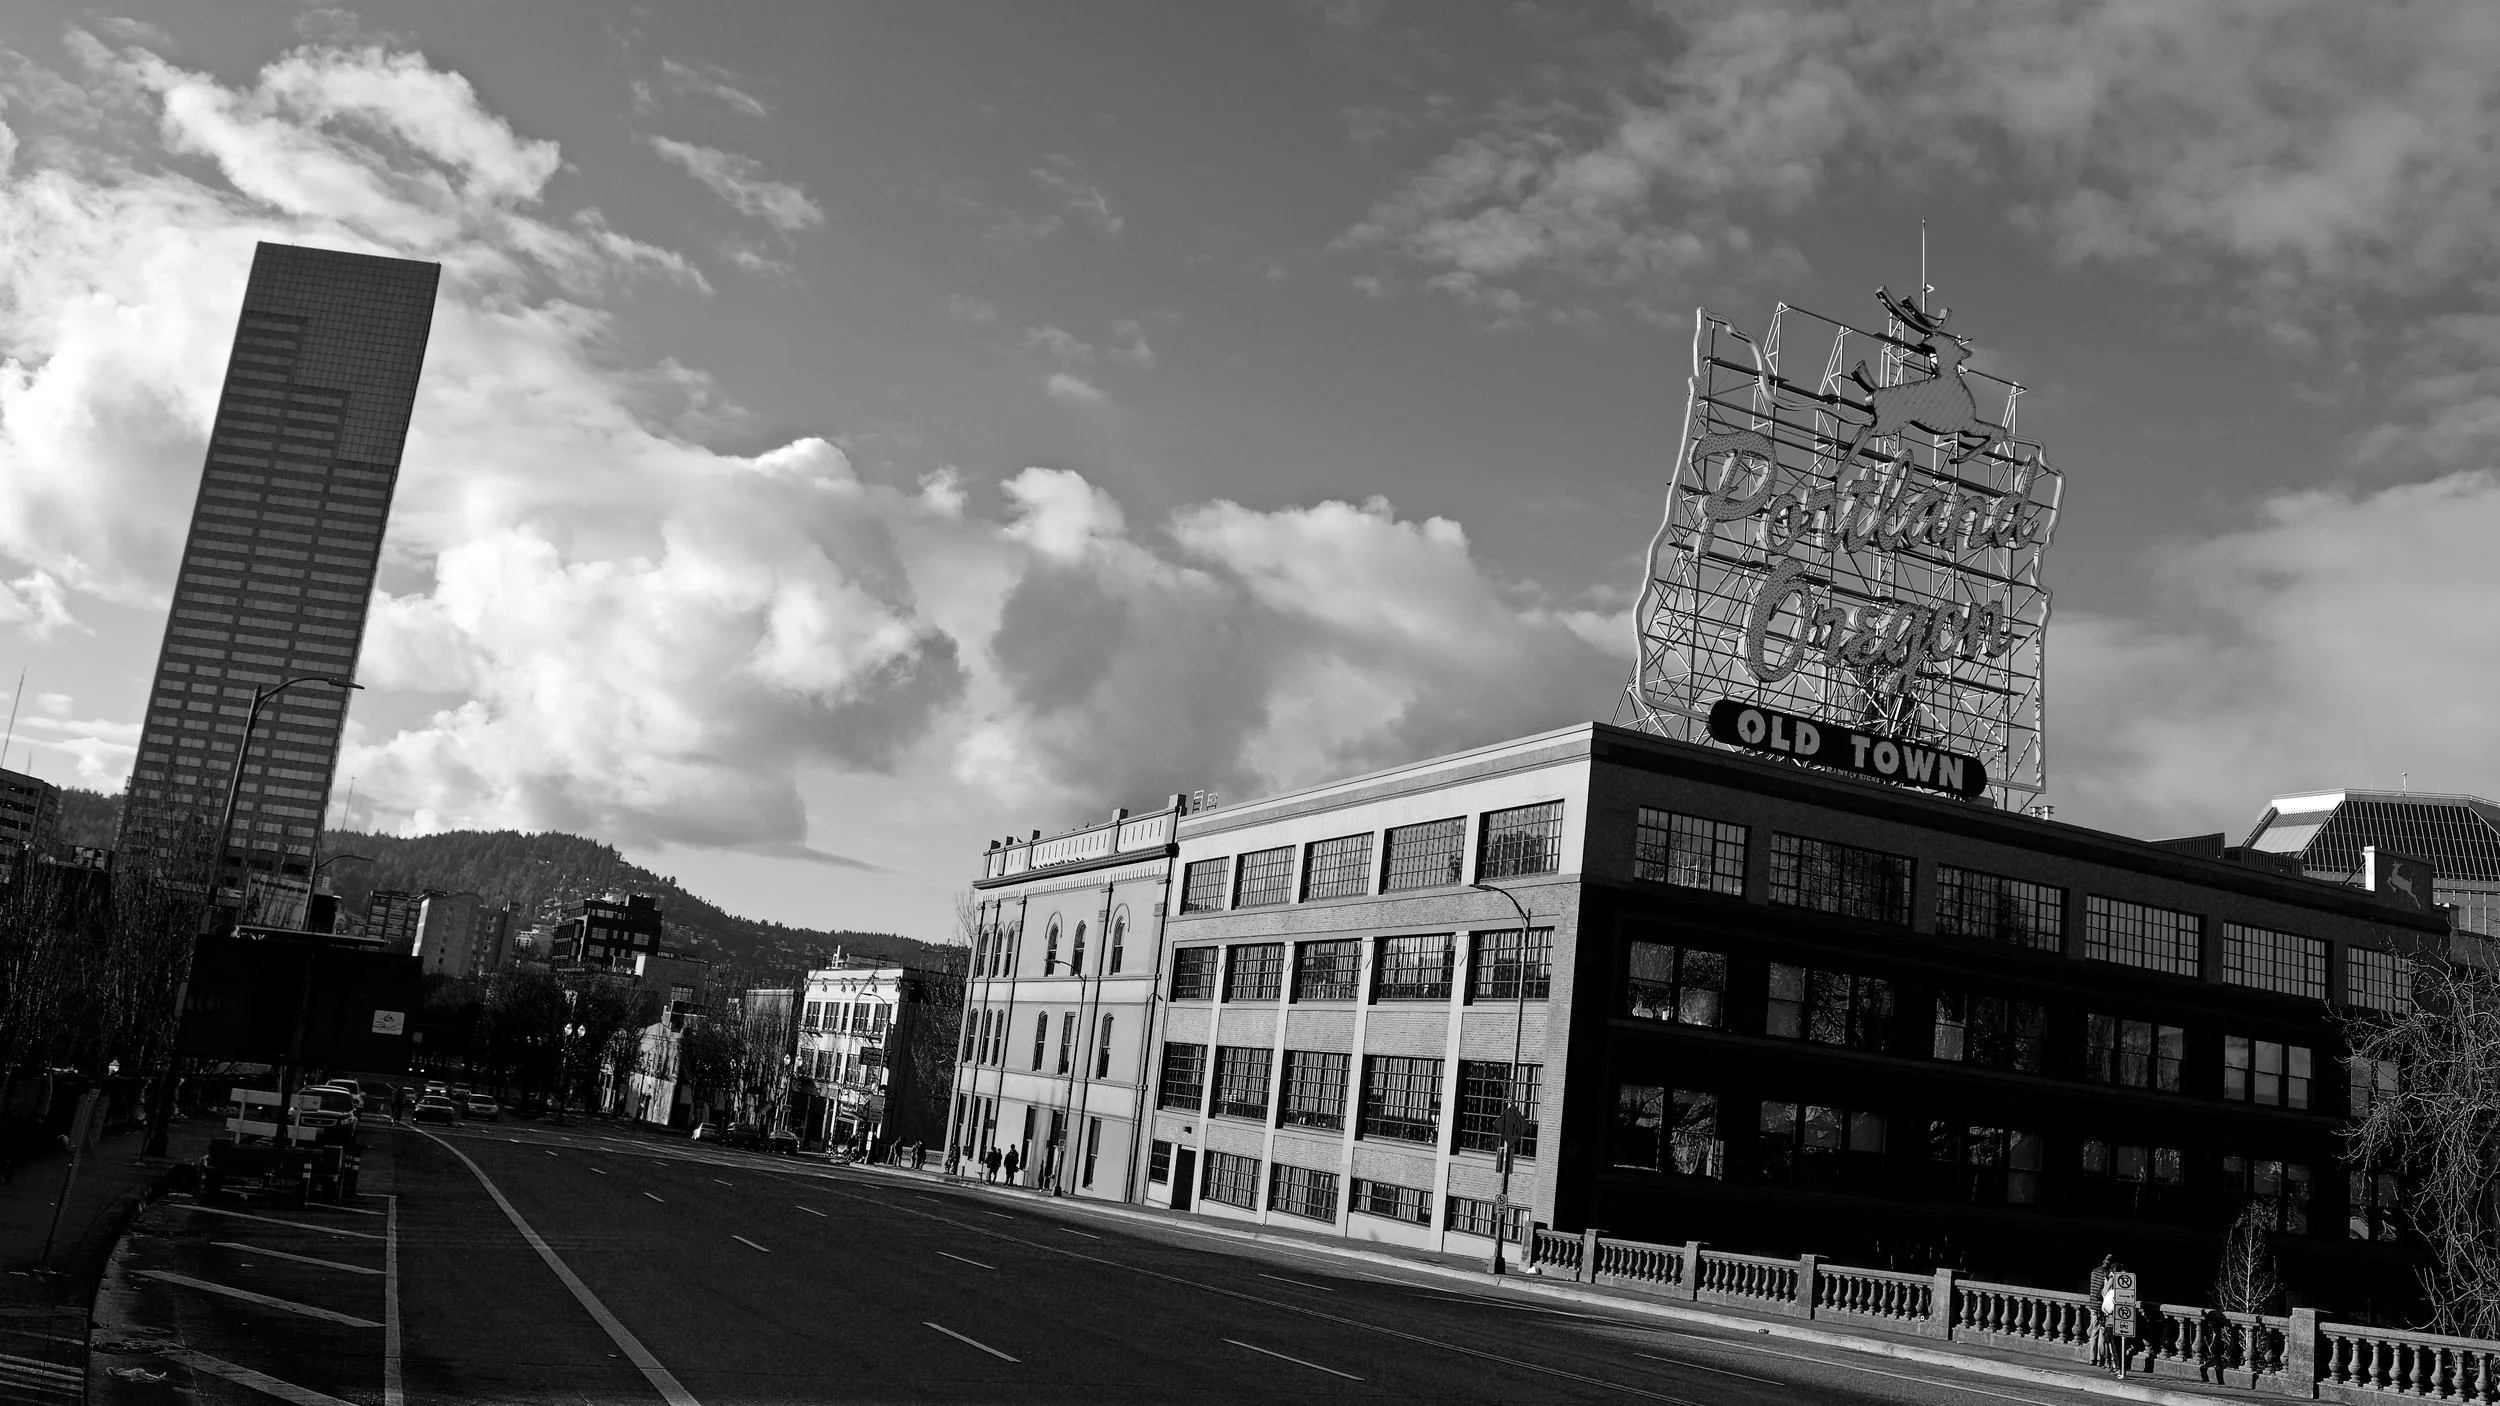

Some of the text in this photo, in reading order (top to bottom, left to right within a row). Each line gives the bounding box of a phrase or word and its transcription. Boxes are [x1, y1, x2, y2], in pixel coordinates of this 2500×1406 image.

[1690, 431, 2039, 558] Portland
[1746, 558, 2014, 695] Oregon
[1737, 709, 1964, 790] OLD TOWN
